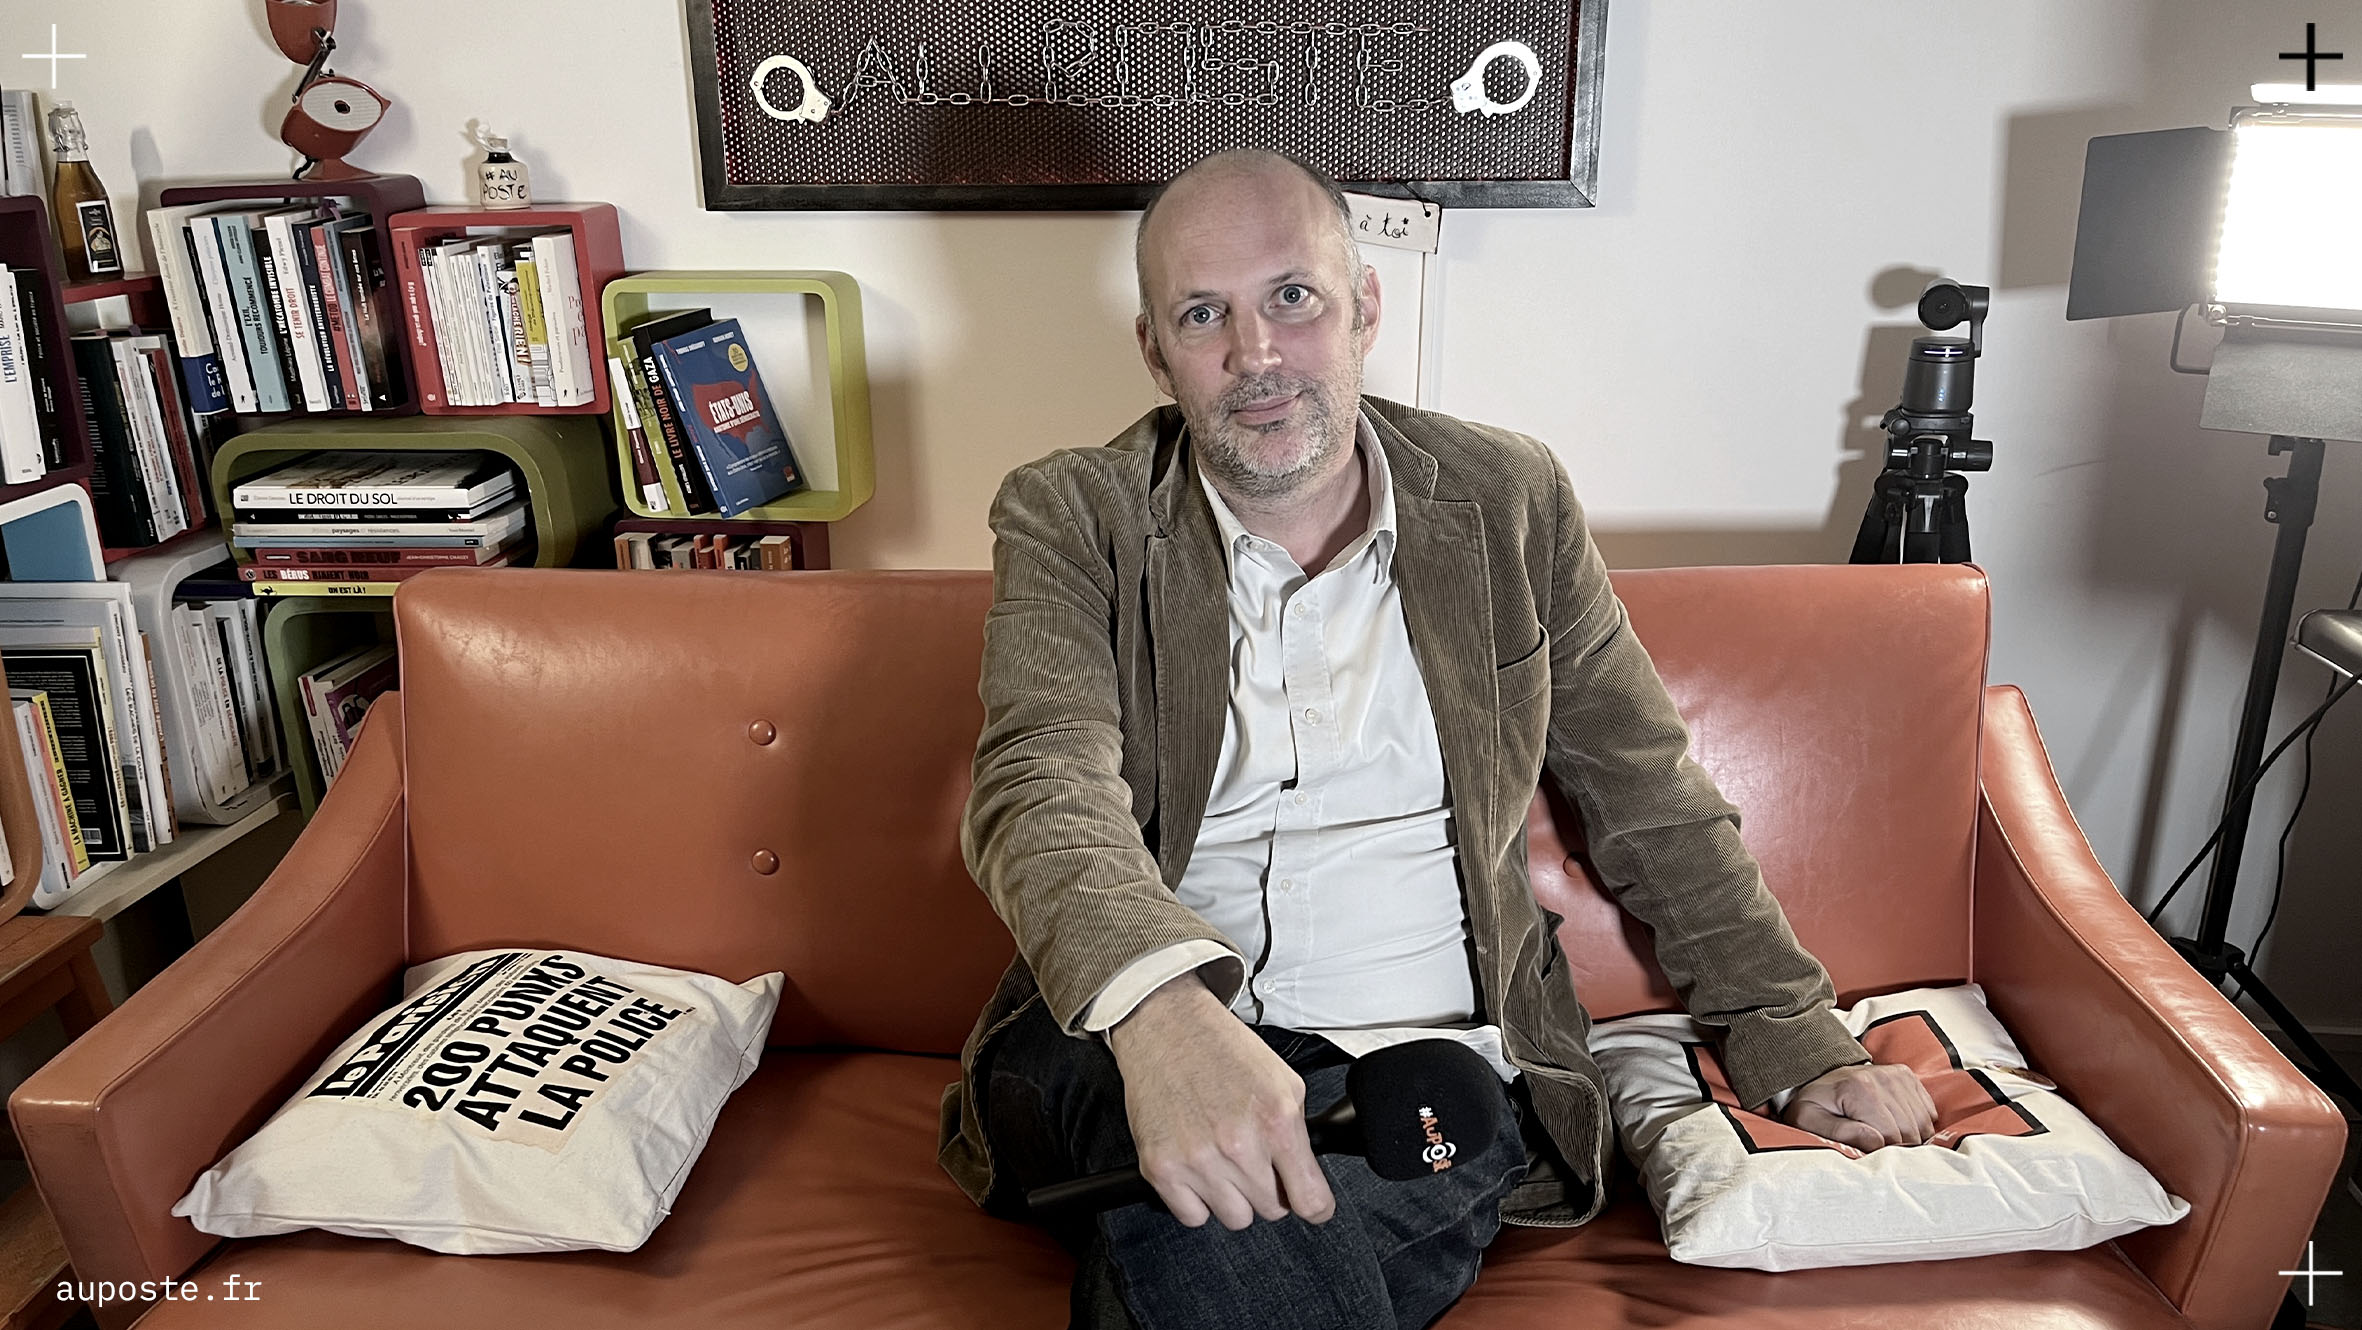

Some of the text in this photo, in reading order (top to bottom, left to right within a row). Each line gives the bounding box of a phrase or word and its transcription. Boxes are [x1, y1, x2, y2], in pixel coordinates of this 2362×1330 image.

[483, 184, 527, 200] POSTE
[1360, 212, 1409, 238] à toi
[264, 256, 278, 289] INVISIBLE
[286, 287, 305, 339] SE TENIR DROIT
[327, 303, 341, 331] #METOO
[0, 335, 17, 383] L'EMPRISE
[643, 356, 660, 383] GAZA
[652, 384, 664, 396] DE
[656, 400, 672, 422] NOIR
[708, 390, 754, 425] ÉTATS-UNIS
[664, 424, 680, 448] LIVRE
[672, 448, 684, 459] LE
[289, 493, 398, 504] LE DROIT DU SOL
[296, 551, 349, 563] SANG
[263, 570, 278, 579] LES
[280, 568, 310, 580] BÉRUS
[55, 768, 69, 796] GAGNER
[63, 803, 79, 834] MACHINE
[72, 834, 81, 845] LA
[403, 954, 586, 1111] 200 PUNKS
[454, 975, 635, 1131] ATTAQUENT
[518, 997, 683, 1131] LA POLICE
